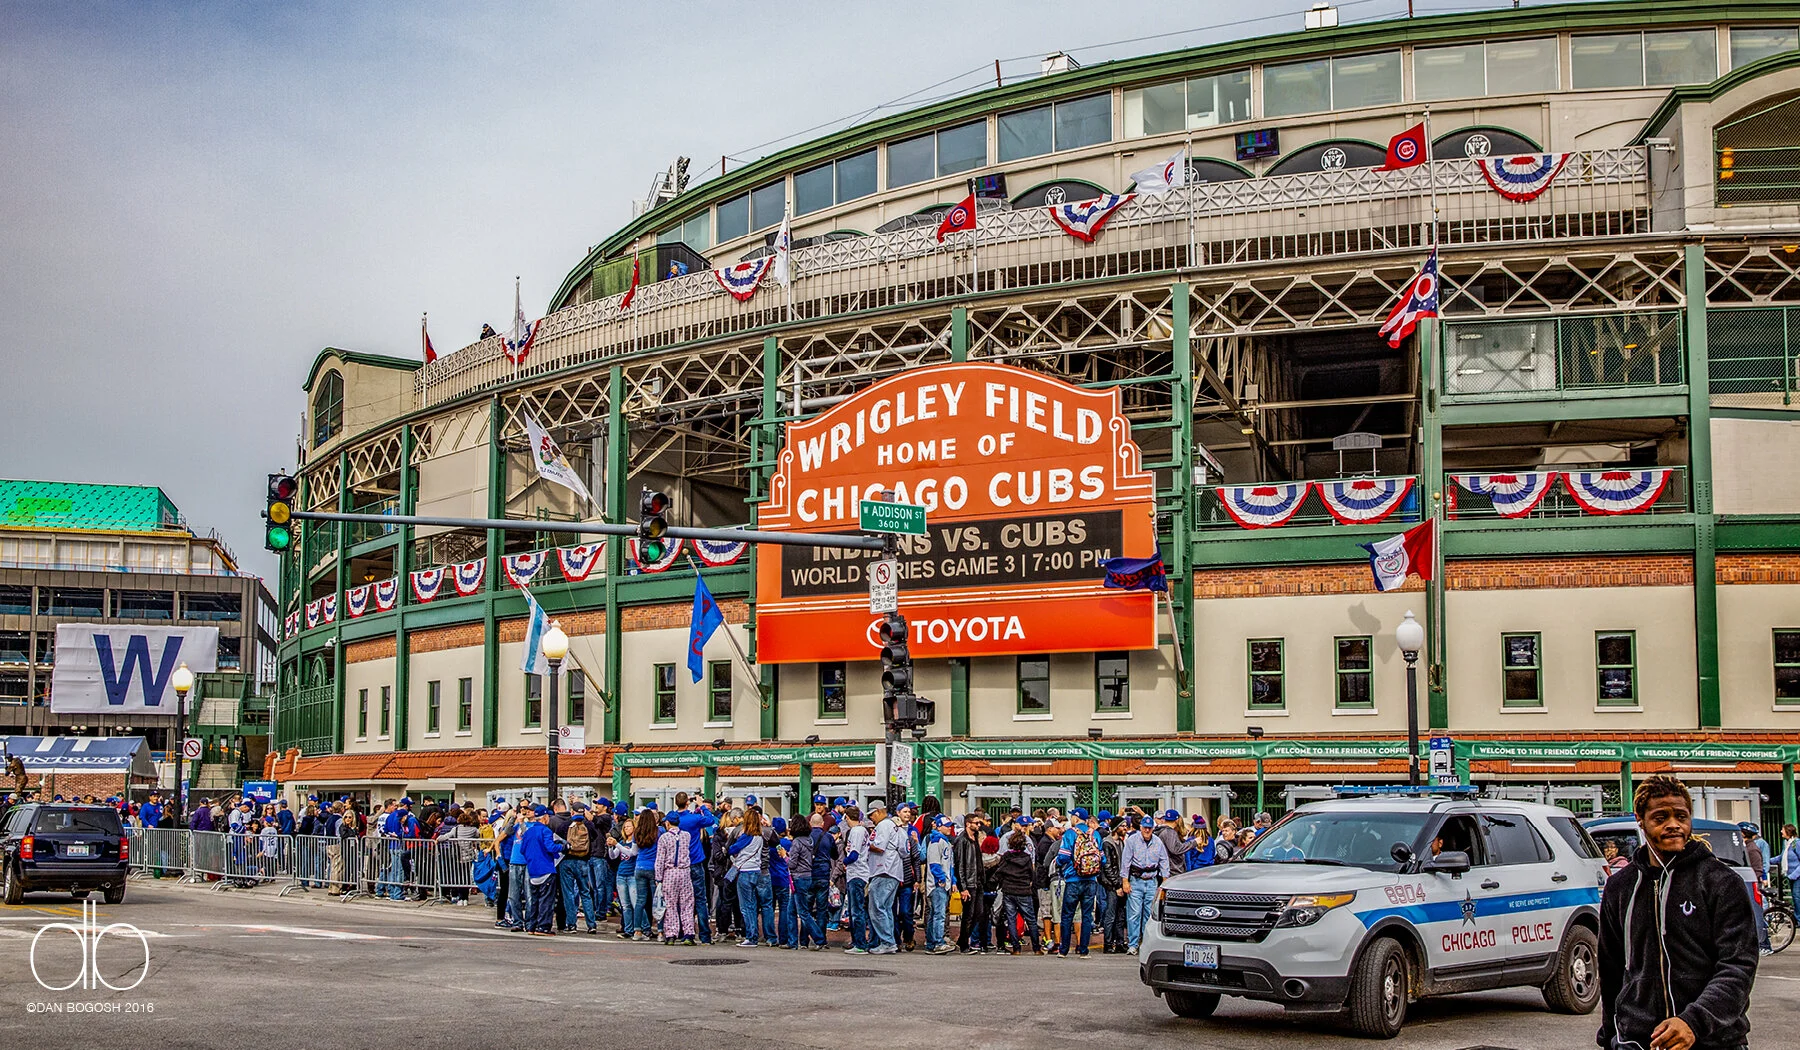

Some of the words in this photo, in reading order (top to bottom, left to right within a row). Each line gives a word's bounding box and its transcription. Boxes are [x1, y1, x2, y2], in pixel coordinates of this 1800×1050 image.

[797, 381, 966, 473] WRIGLEY
[985, 382, 1104, 444] FIELD
[877, 438, 956, 466] HOME
[978, 432, 1016, 456] OF
[796, 475, 969, 523] CHICAGO
[988, 465, 1105, 508] CUBS
[872, 506, 912, 520] ADDISON
[914, 510, 922, 519] ST
[878, 520, 900, 529] 3600
[941, 527, 988, 552] VS.
[1000, 518, 1087, 550] CUBS
[791, 565, 860, 586] WORLD
[866, 560, 935, 581] RIES
[940, 550, 998, 576] GAME
[1004, 552, 1015, 572] 3
[1032, 550, 1074, 572] 7:00
[1084, 548, 1111, 570] PM
[910, 616, 1026, 644] TOYOTA
[92, 634, 184, 706] W
[1384, 883, 1426, 904] 8904
[1442, 929, 1496, 952] CHICAGO
[1512, 922, 1554, 944] POLICE
